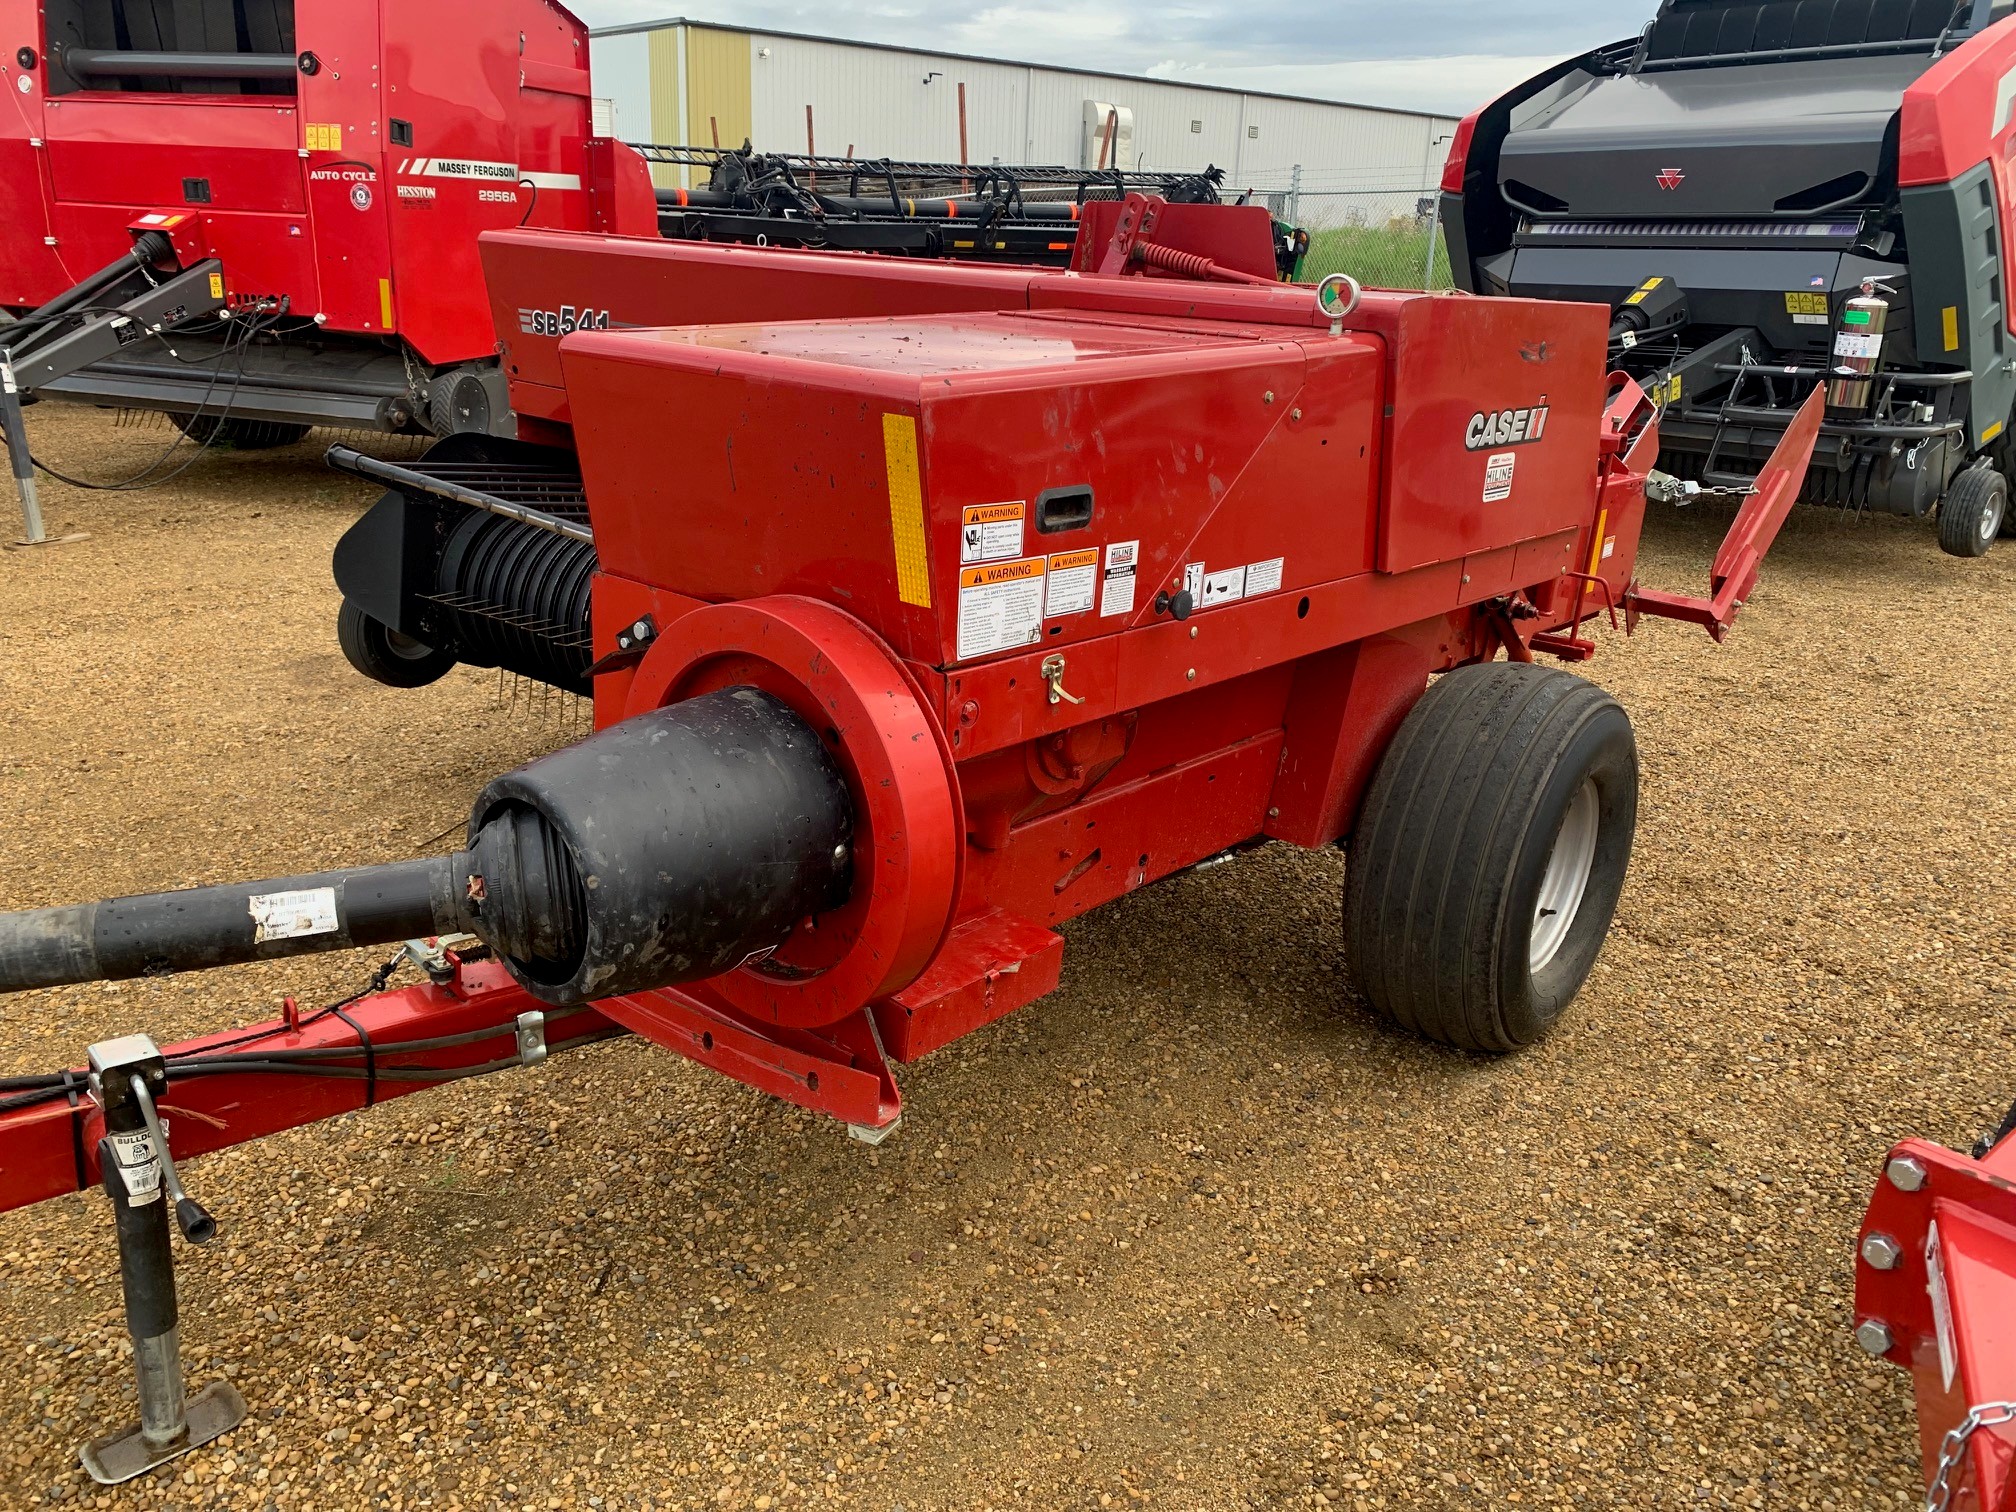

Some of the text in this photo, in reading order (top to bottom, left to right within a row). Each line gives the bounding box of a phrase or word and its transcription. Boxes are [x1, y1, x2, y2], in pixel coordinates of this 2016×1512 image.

[438, 162, 515, 177] MASSEY FERGUSON
[310, 171, 377, 181] AUTO CYCLE
[397, 185, 436, 199] HESSTON
[479, 190, 517, 202] 2956A
[981, 507, 1019, 519] WARNING
[1062, 554, 1093, 566] WARNING
[987, 565, 1031, 580] WARNING
